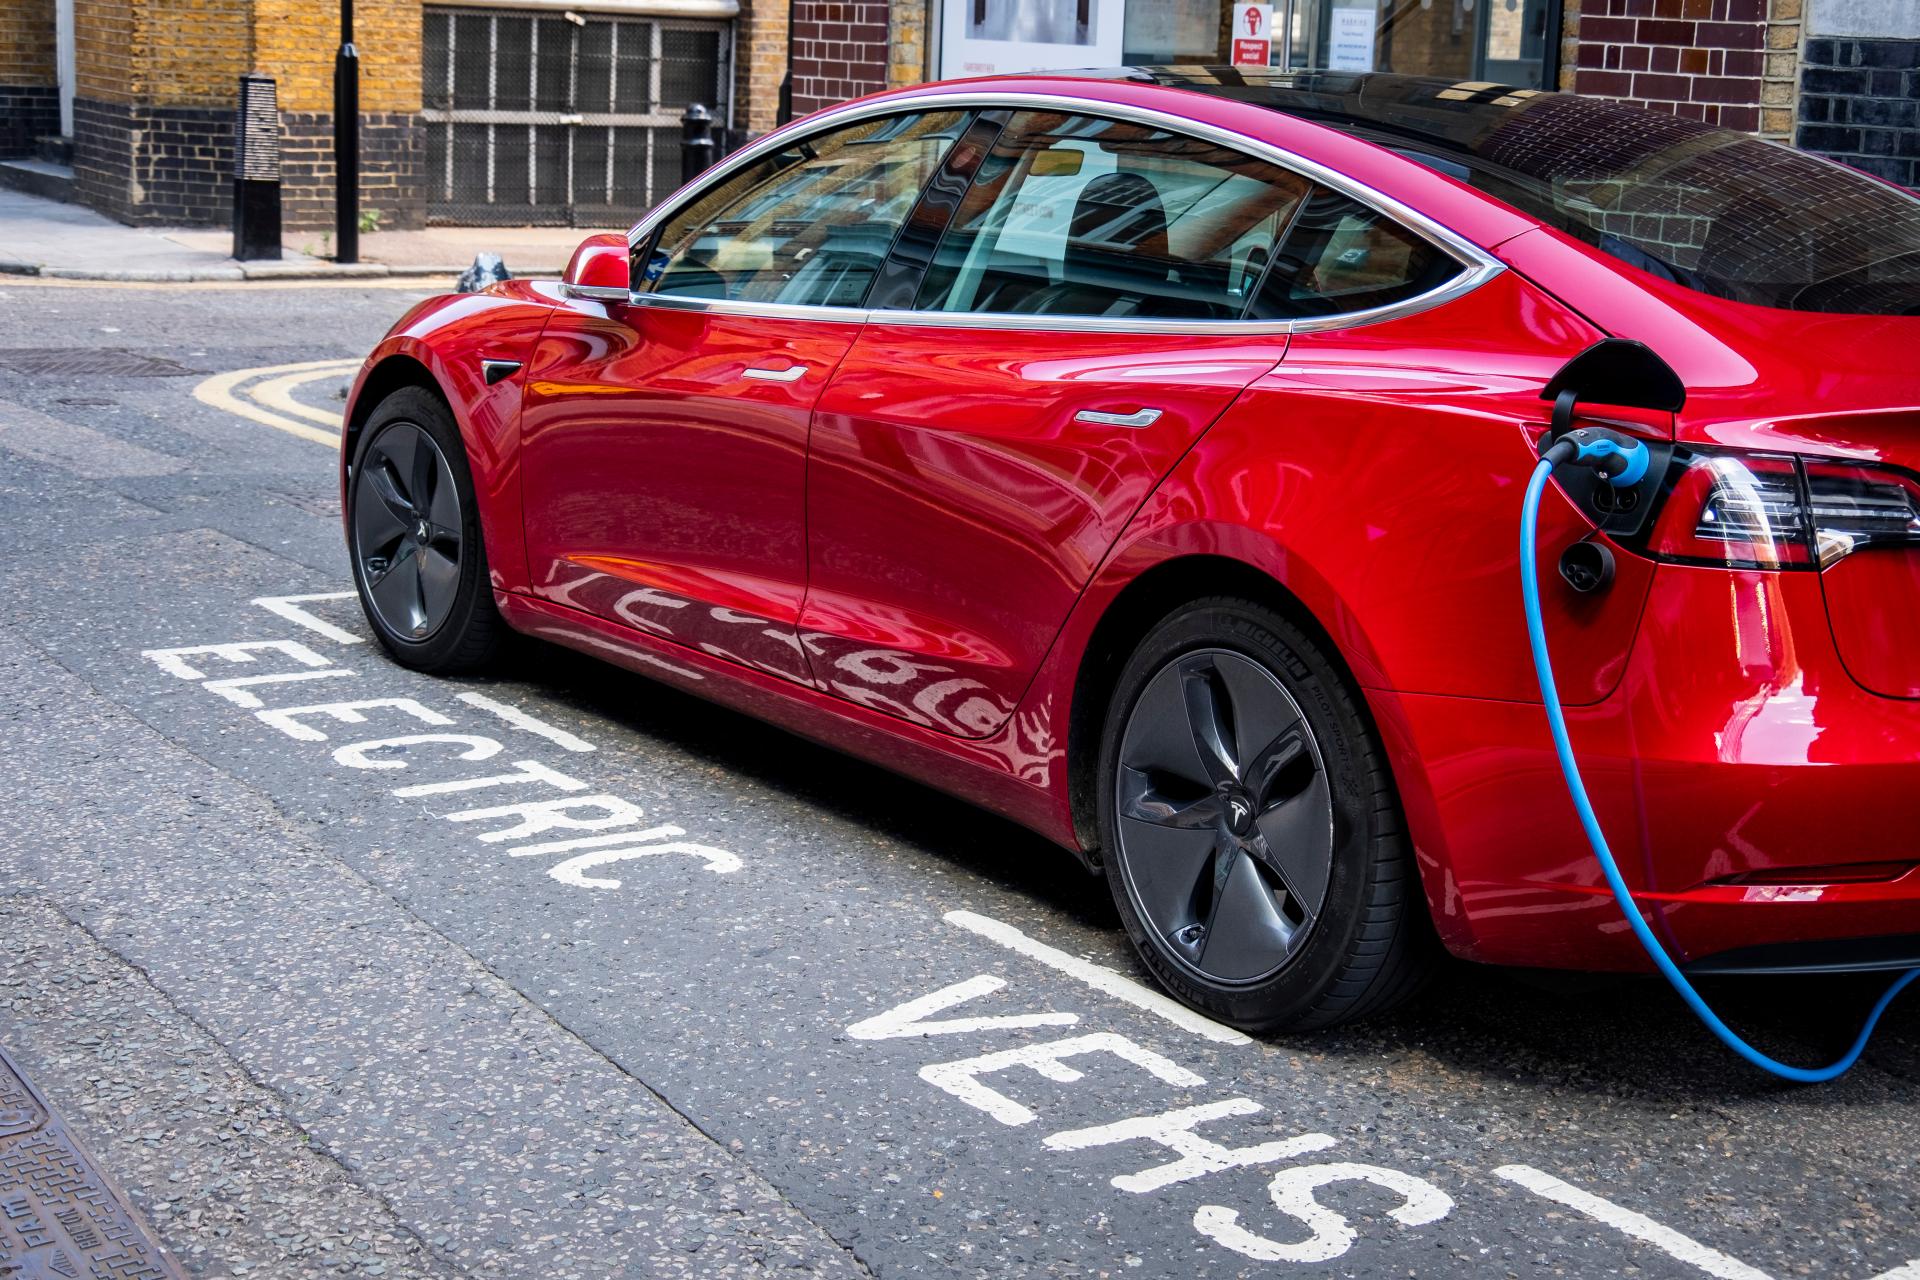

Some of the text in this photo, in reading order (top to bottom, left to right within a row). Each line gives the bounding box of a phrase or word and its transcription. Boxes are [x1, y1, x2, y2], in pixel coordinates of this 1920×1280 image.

[1233, 620, 1308, 677] MICHELIN
[1311, 686, 1333, 717] PILOT
[1329, 721, 1350, 763] SPORT
[142, 640, 744, 889] ELECTRIC
[845, 974, 1455, 1263] VEHS
